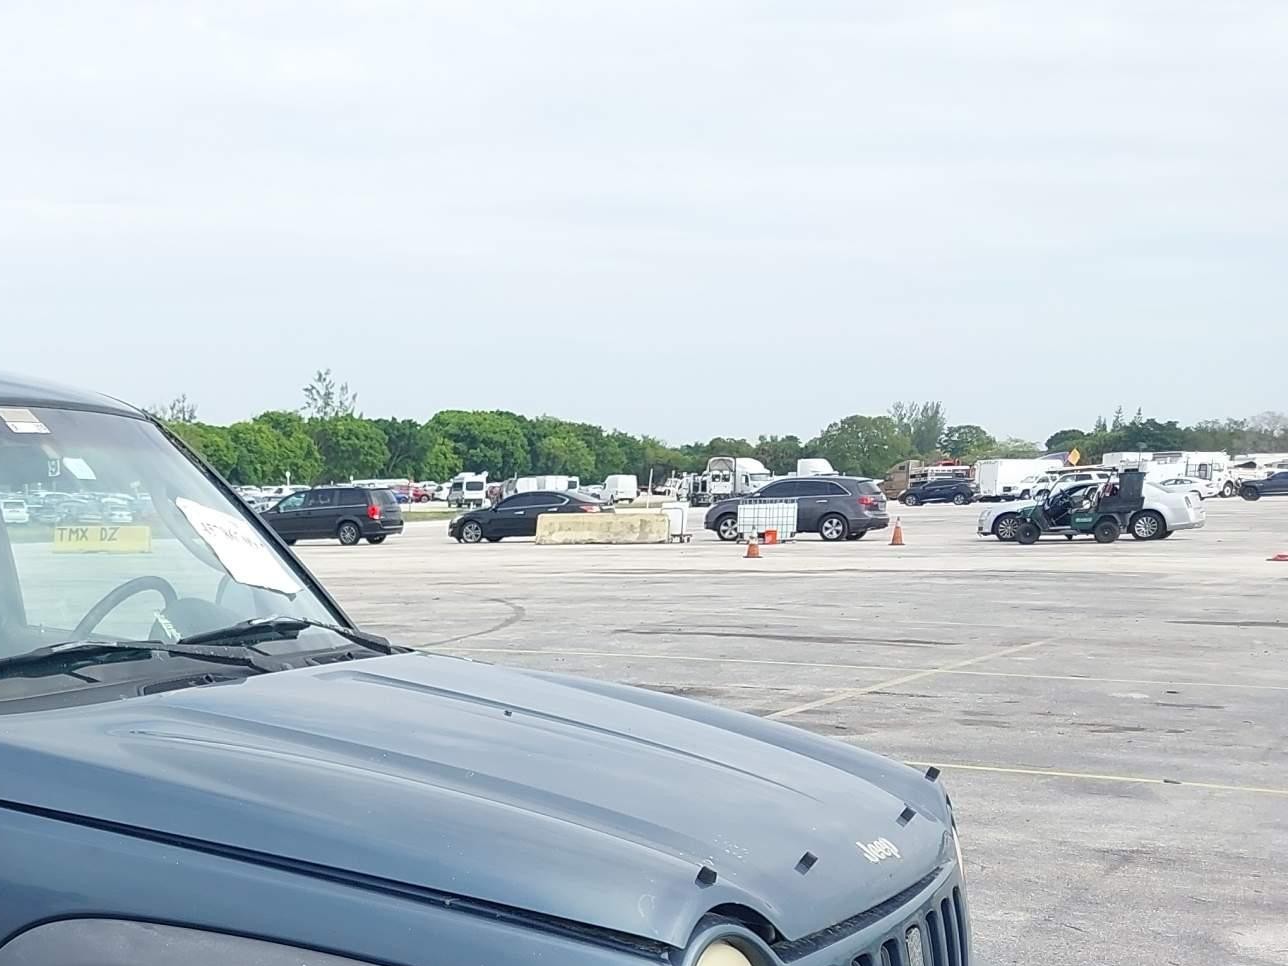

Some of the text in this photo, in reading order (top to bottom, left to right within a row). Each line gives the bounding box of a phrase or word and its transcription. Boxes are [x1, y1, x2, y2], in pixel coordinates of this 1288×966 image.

[57, 526, 121, 542] TMX DZ
[855, 837, 901, 862] Jeep
